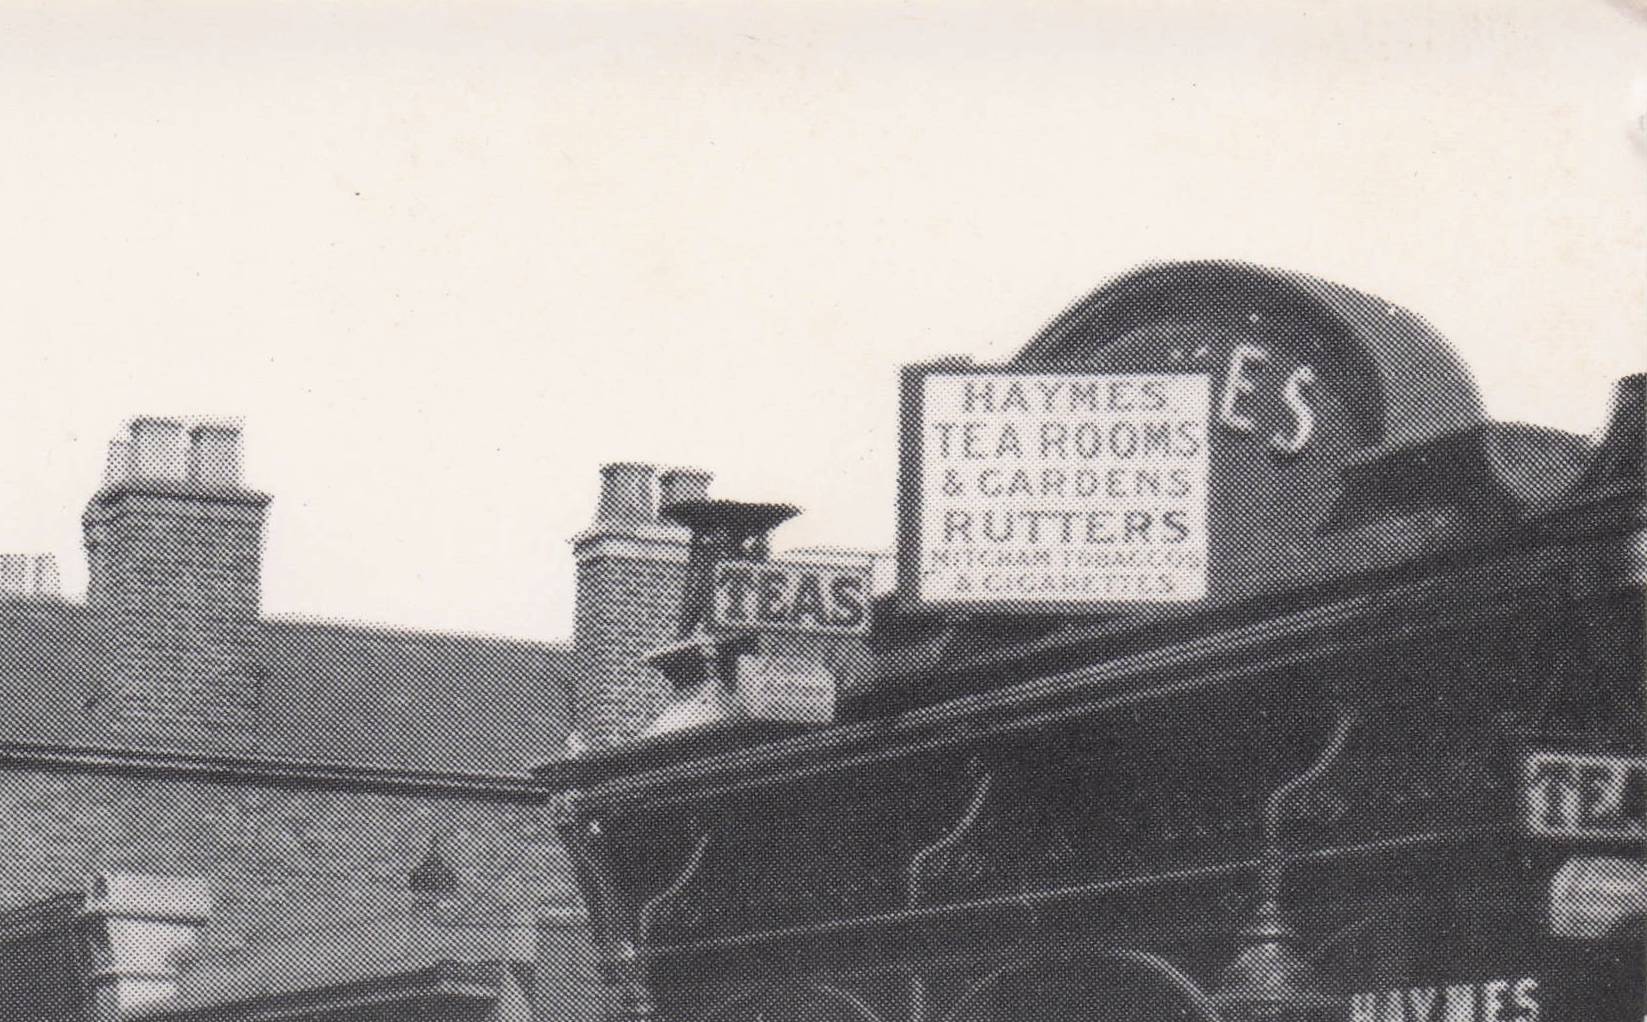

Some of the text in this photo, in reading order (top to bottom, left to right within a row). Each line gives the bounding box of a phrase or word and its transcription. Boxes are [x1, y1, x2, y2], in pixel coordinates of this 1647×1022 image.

[932, 420, 1201, 460] TEA ROOMS
[940, 468, 1193, 498] & GARDENS
[942, 508, 1191, 546] RUTTERS
[930, 549, 1052, 571] MITCHAM
[717, 566, 865, 628] TEAS
[954, 573, 1176, 595] & CIGARETTES
